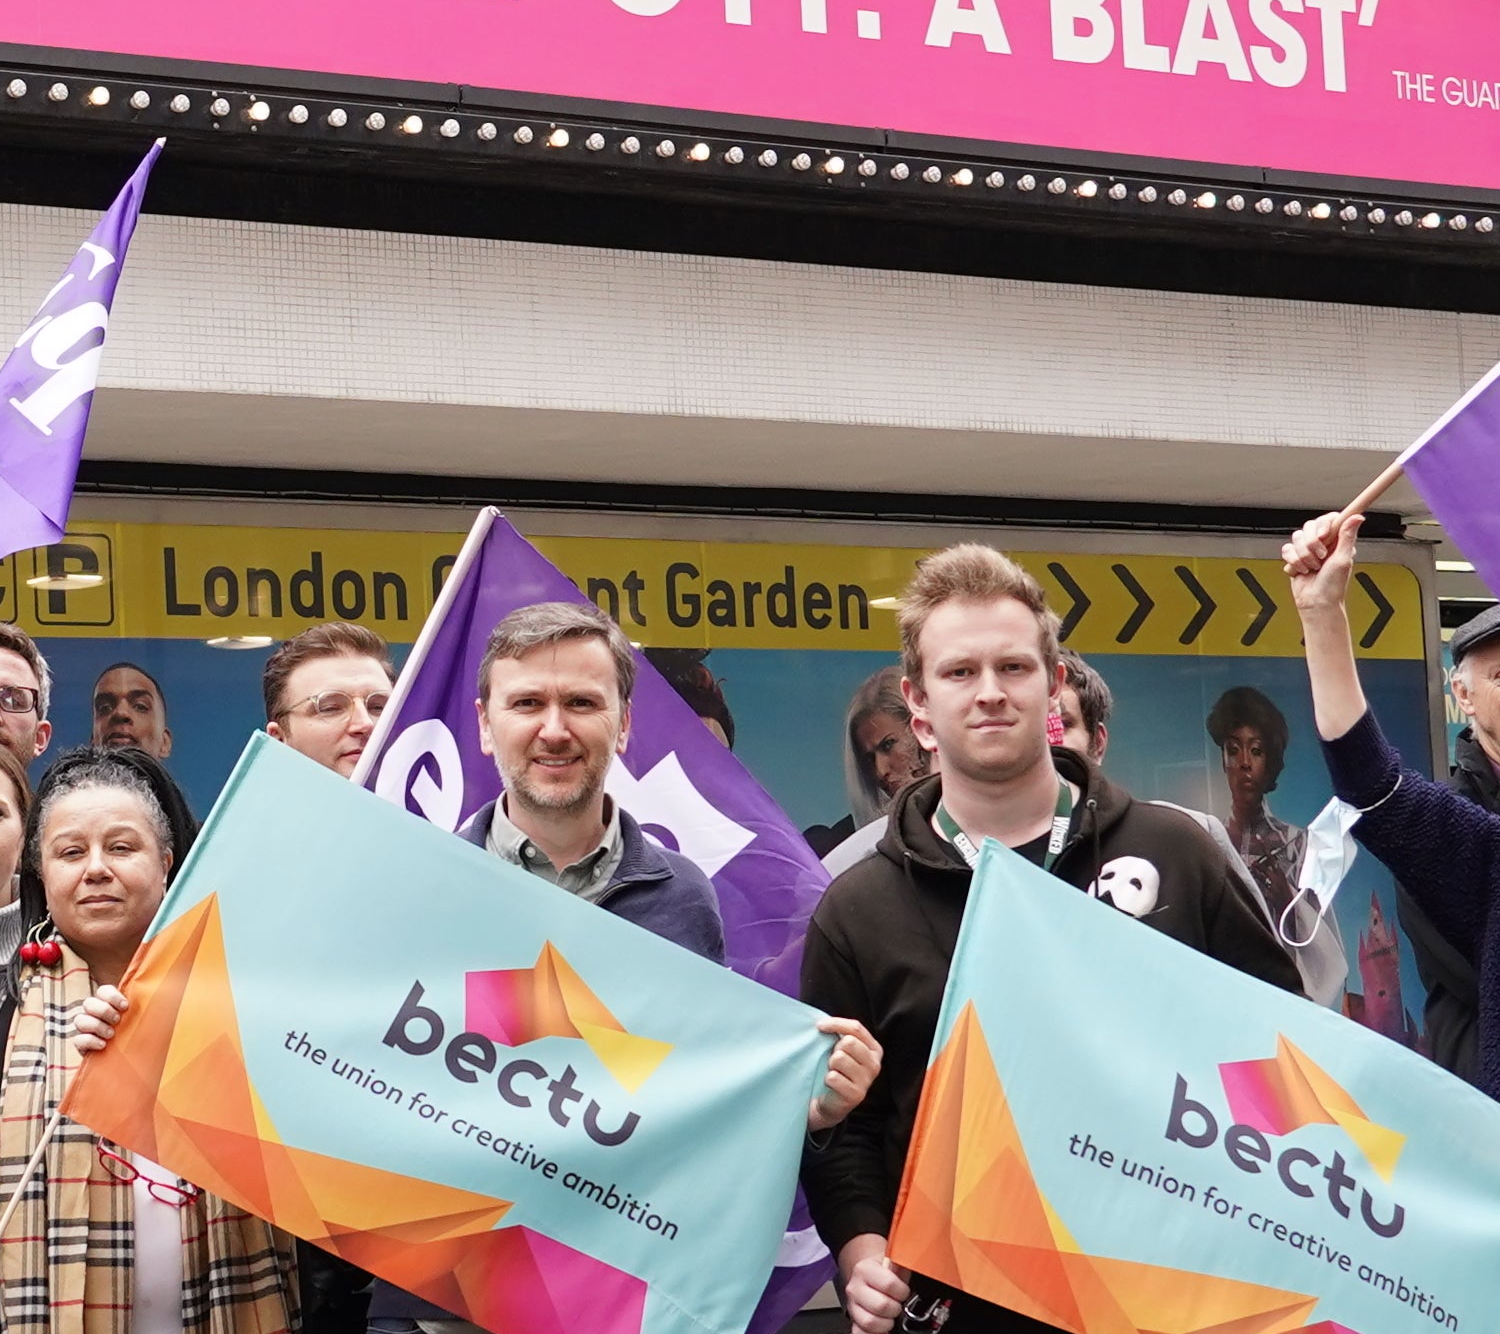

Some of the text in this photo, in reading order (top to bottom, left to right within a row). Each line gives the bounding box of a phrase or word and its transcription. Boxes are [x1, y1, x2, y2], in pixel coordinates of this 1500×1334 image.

[1392, 70, 1436, 103] THE
[163, 547, 409, 622] London
[665, 562, 870, 631] Garden
[283, 1028, 680, 1242] the union for creative ambition
[383, 979, 642, 1147] bectu
[1068, 1133, 1459, 1333] the union for creative ambition
[1164, 1071, 1406, 1239] bectu
